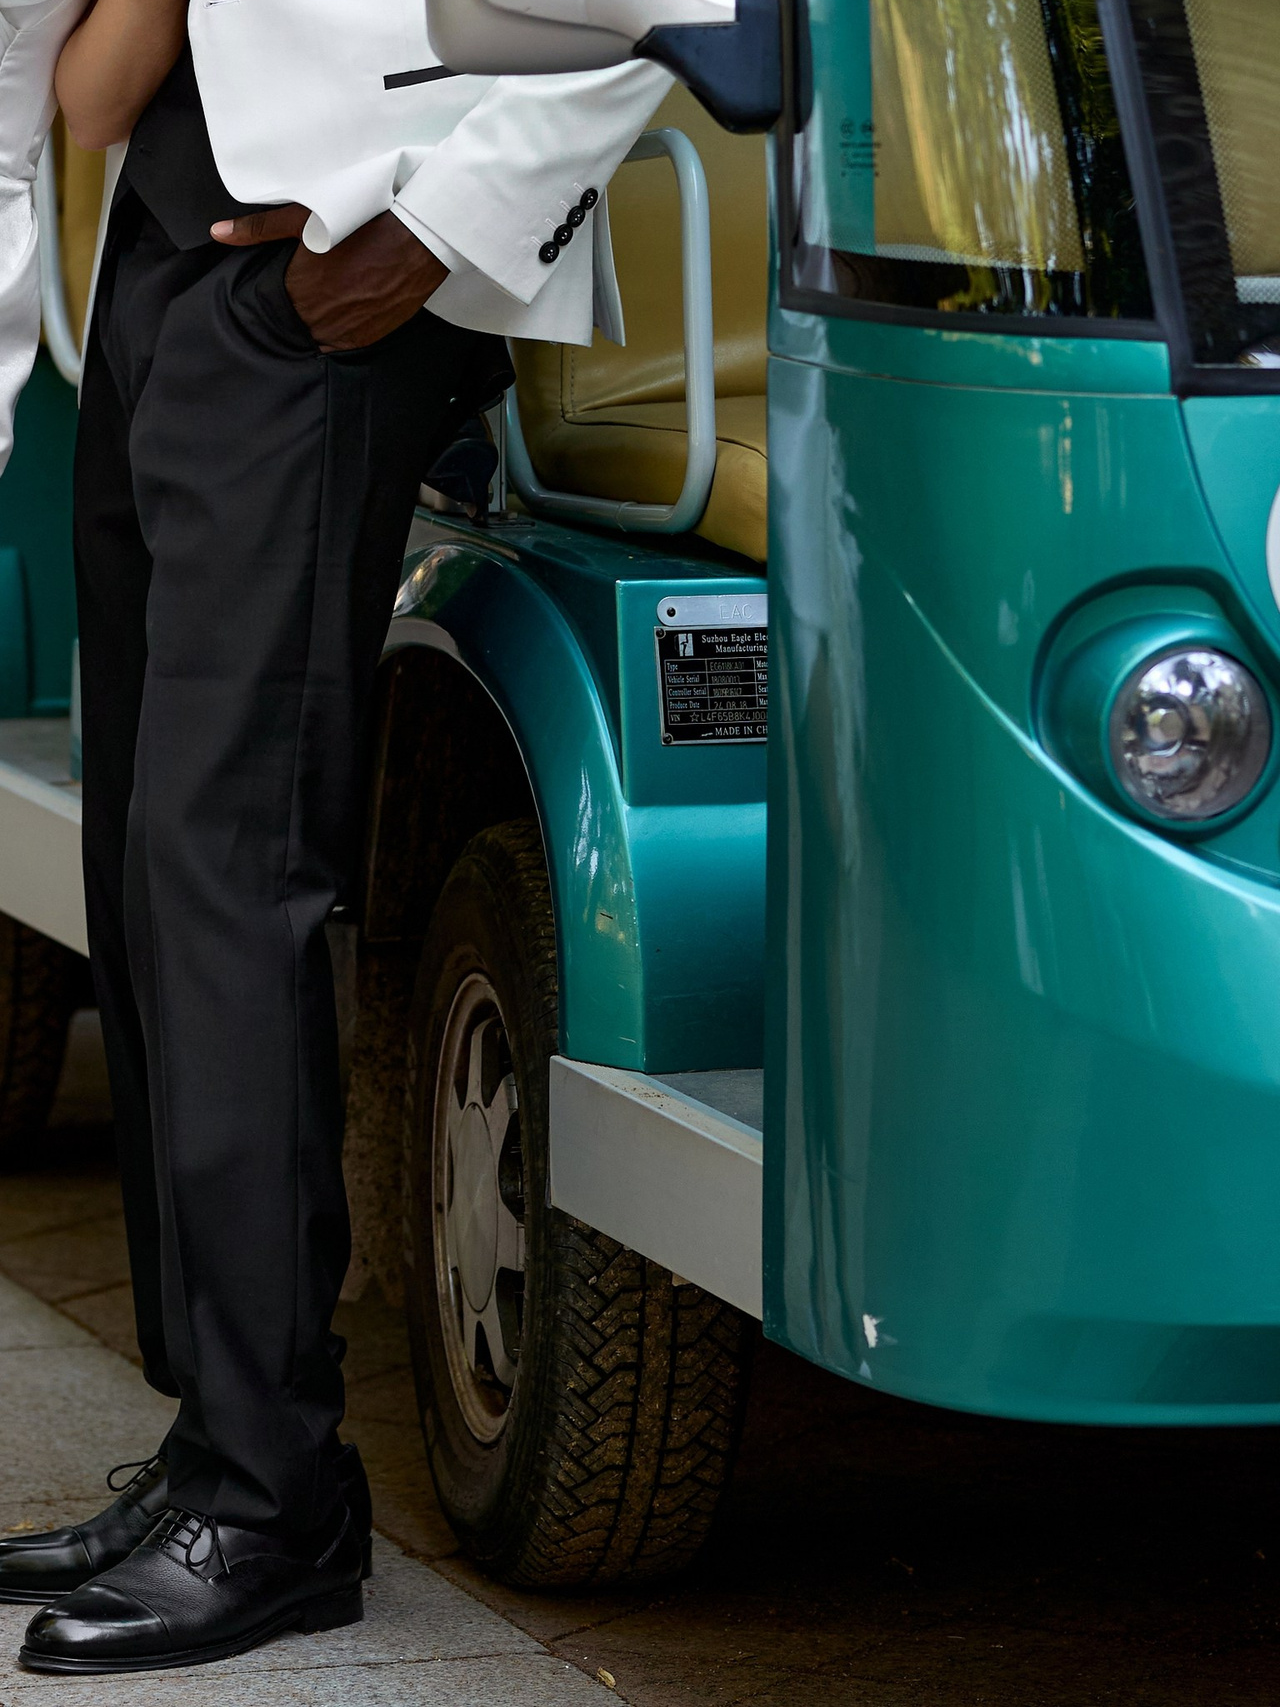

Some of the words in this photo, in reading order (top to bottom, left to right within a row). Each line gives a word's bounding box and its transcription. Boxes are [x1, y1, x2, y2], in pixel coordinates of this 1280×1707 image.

[719, 603, 754, 620] EAC
[701, 634, 728, 644] Suzhou
[731, 633, 751, 643] Eagle
[715, 643, 768, 654] Manufacturing
[666, 662, 679, 672] Type
[667, 675, 685, 684] Vehicle
[685, 674, 700, 684] Serial
[668, 688, 692, 697] Controller
[692, 686, 707, 696] Serial
[669, 701, 688, 710] Produce
[688, 700, 700, 709] Date
[670, 713, 681, 722] VIN
[700, 711, 768, 722] L4F65B8K4J00
[714, 726, 741, 736] MADE
[743, 725, 753, 735] IN
